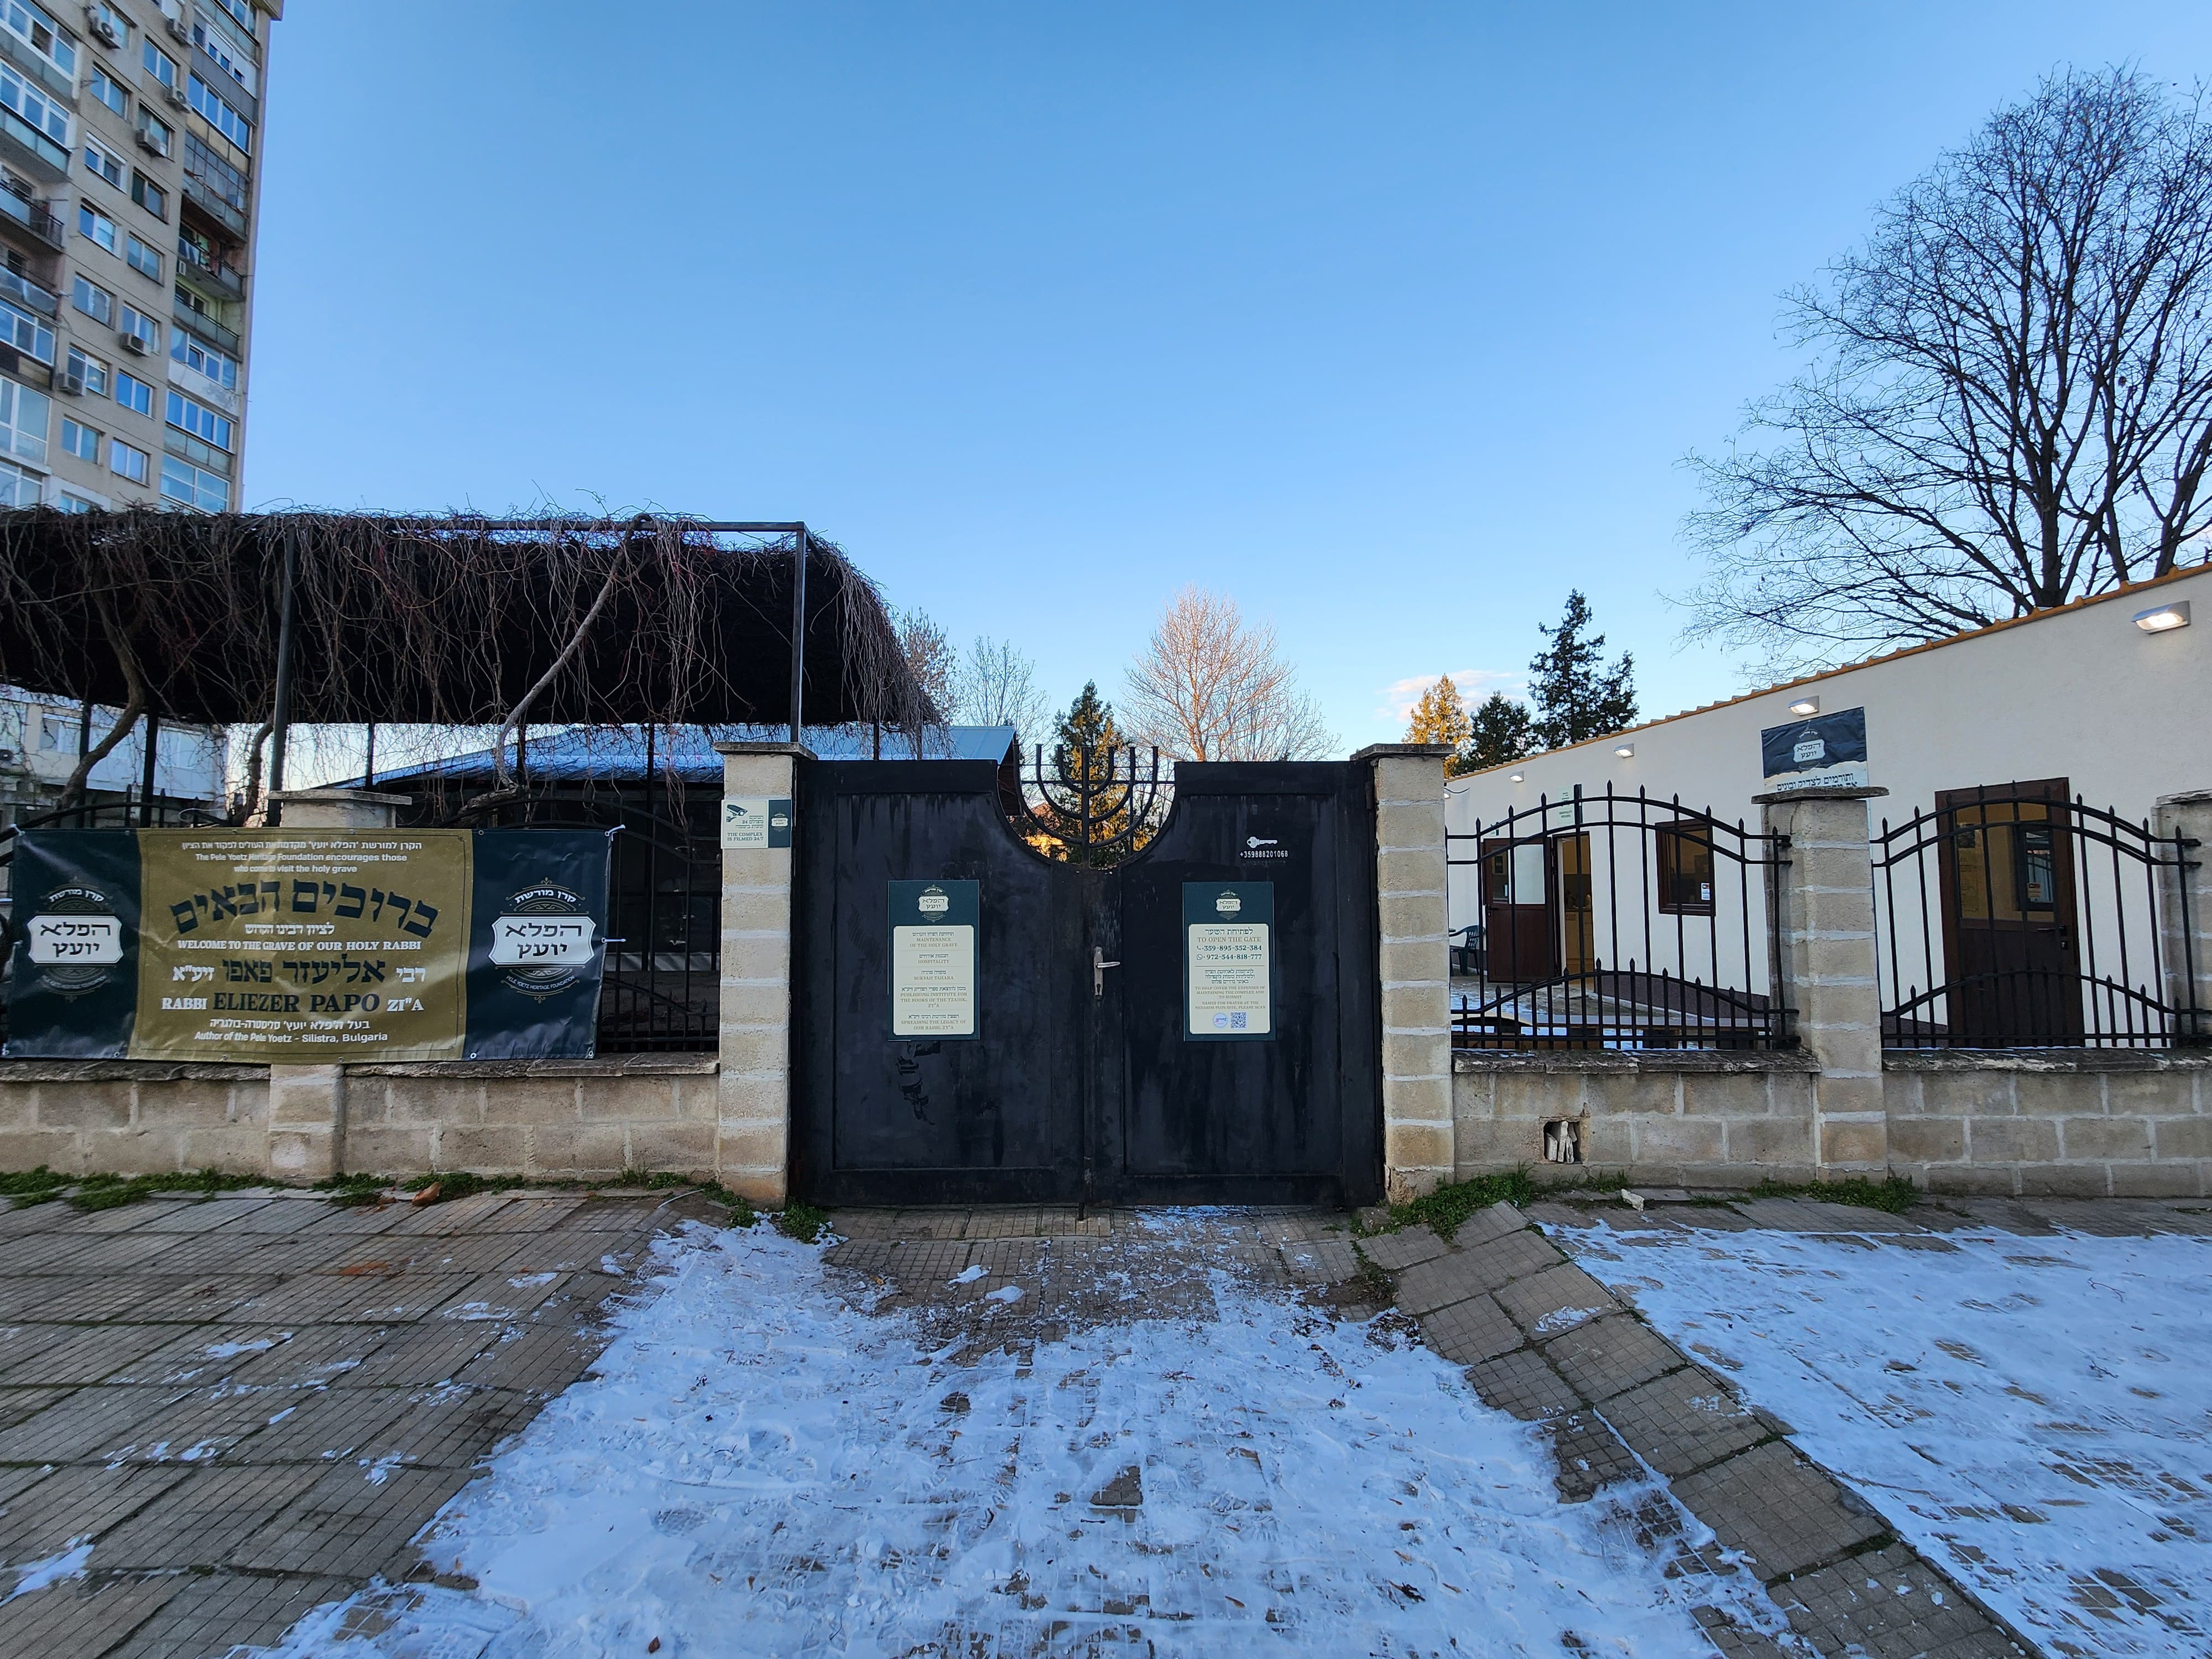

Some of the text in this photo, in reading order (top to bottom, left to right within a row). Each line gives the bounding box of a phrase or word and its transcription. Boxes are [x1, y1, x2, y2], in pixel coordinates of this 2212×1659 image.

[1797, 743, 1821, 752] הפלא
[1801, 750, 1817, 759] יועץ
[1798, 776, 1821, 788] לצדיק
[1824, 773, 1854, 784] ותורמים
[1777, 781, 1796, 791] ובונים
[214, 841, 237, 849] לפקוד
[400, 842, 422, 851] הקרן
[312, 865, 331, 874] holy
[514, 889, 577, 904] קרן מורשת
[169, 878, 439, 938] ברוכים הבאים
[40, 921, 111, 936] הפלא
[245, 922, 335, 935] לציון רבינו הקדוש
[505, 922, 582, 937] הפלא
[53, 943, 100, 957] יועץ
[178, 940, 422, 950] WELCOME TO THE GRAVE OF OUR HOLY RABBI
[517, 943, 567, 959] יועץ
[223, 959, 273, 983] פאפו
[283, 953, 385, 984] אליעזר
[396, 967, 426, 983] רבי
[505, 975, 517, 985] PELE
[161, 993, 425, 1012] RABBI ELIEZER PAPO ZI"A
[347, 1020, 371, 1030] בעל
[195, 1031, 223, 1040] Author
[223, 1031, 234, 1041] of
[235, 1032, 248, 1041] the
[251, 1033, 266, 1041] Pele
[268, 1034, 293, 1042] Yoetz
[302, 1034, 339, 1043] Silistra,
[342, 1032, 388, 1042] Bulgaria
